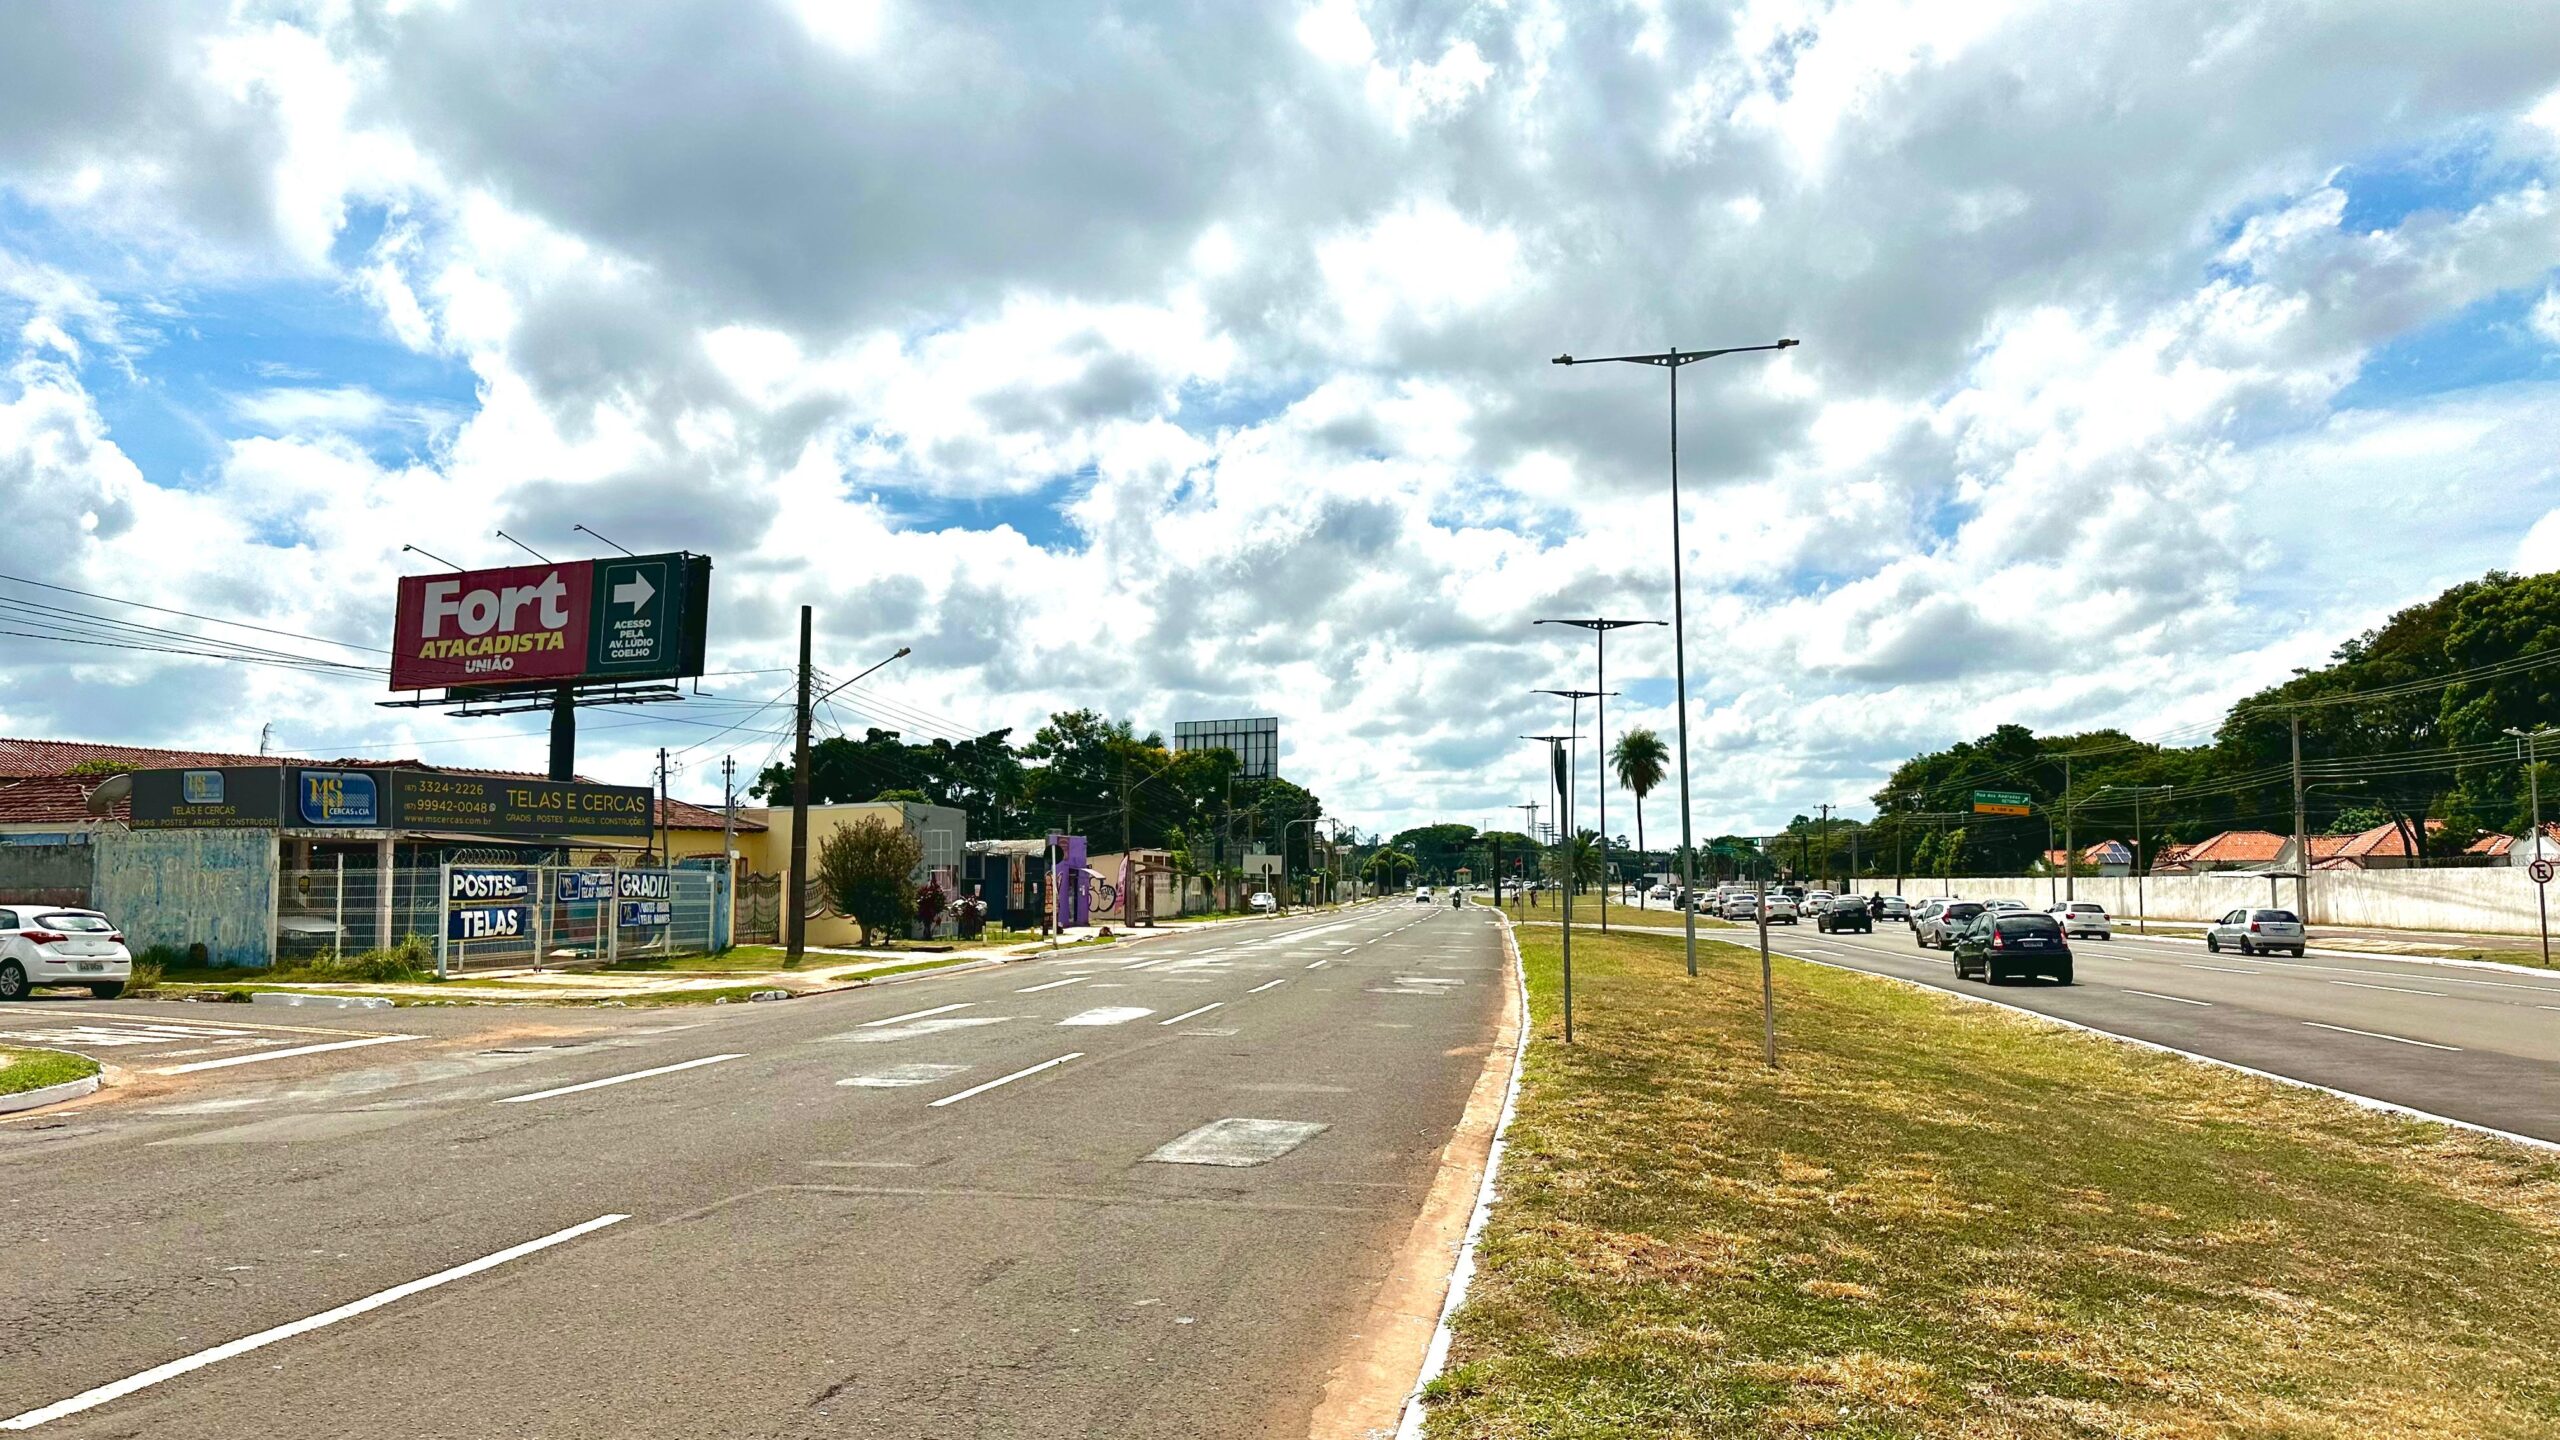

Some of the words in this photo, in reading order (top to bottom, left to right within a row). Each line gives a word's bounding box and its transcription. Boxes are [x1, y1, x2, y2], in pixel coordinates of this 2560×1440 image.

[422, 571, 568, 638] Fort
[613, 619, 652, 629] ACESSO
[619, 629, 644, 639] PELA
[418, 631, 565, 659] ATACADISTA
[609, 639, 624, 649] AV.
[625, 637, 654, 648] LÚDIO
[611, 647, 650, 658] COELHO
[464, 655, 514, 674] UNIÃO
[419, 780, 484, 795] 3324-2226
[417, 799, 487, 814] 99942-0048
[506, 789, 561, 809] TELAS
[567, 793, 577, 810] E
[582, 794, 646, 813] CERCAS
[172, 806, 196, 815] TELAS
[197, 806, 202, 815] E
[205, 806, 236, 815] CERCAS
[329, 807, 354, 816] CERCAS
[358, 808, 370, 816] CIA
[131, 819, 156, 827] GRADIS
[160, 819, 187, 827] POSTES
[192, 818, 221, 827] ARAMES
[225, 816, 278, 827] CONSTRUÇÕES
[404, 815, 492, 825] www.mscercas.com.br
[506, 813, 532, 823] GRADIS
[537, 814, 564, 824] POSTES
[569, 816, 596, 825] ARAMES
[600, 816, 646, 827] CONSTRUÇÕES
[452, 874, 512, 897] POSTES
[620, 874, 669, 898] GRADIL
[460, 909, 518, 938] TELAS
